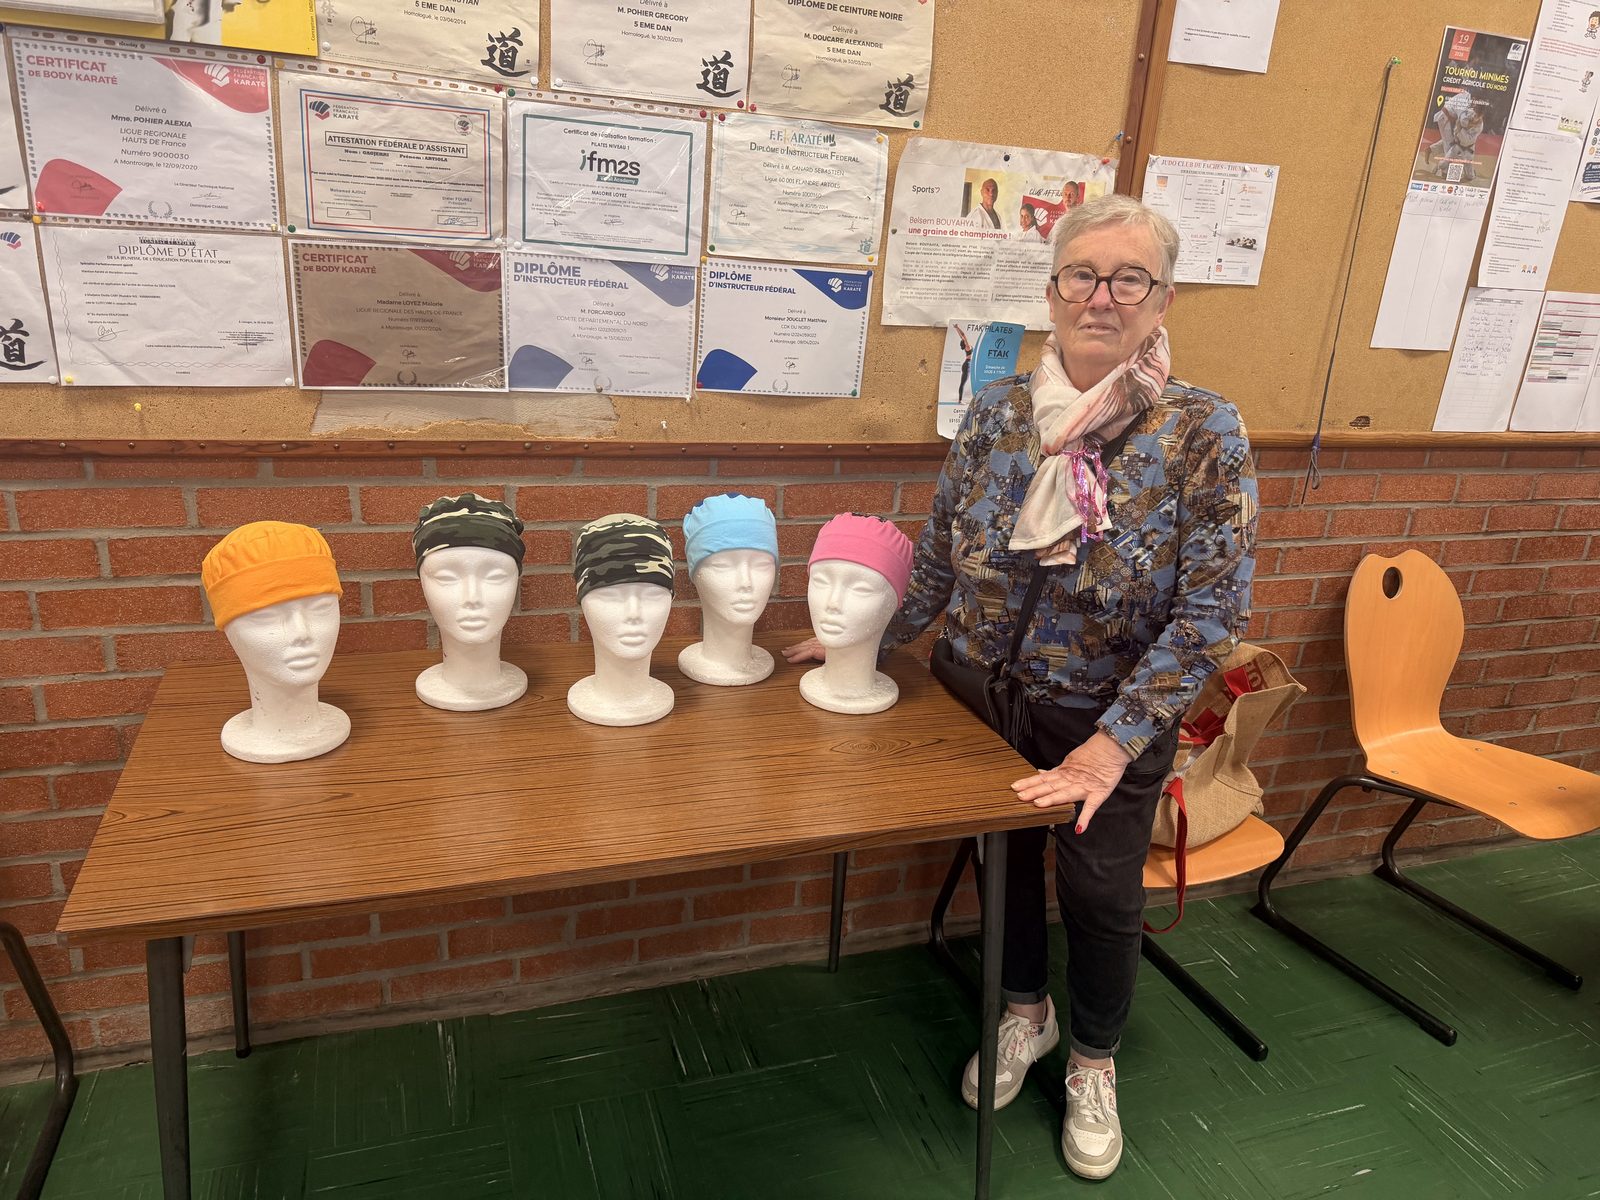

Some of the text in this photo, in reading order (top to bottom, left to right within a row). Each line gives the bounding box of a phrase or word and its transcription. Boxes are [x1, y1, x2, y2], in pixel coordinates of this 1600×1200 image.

[422, 2, 438, 10] EME
[440, 5, 456, 14] DAN
[840, 5, 878, 17] CEINTURE
[880, 11, 903, 21] NOIRE
[627, 8, 654, 18] POHIER
[654, 12, 688, 22] GREGORY
[640, 22, 655, 30] EME
[832, 25, 854, 34] Délivré
[813, 34, 844, 43] DOUCARE
[845, 38, 883, 48] ALEXANDRE
[1458, 34, 1469, 44] 19
[480, 27, 531, 78] 道
[26, 55, 107, 72] CERTIFICAT
[43, 70, 73, 80] BODY
[76, 73, 118, 85] KARATÉ
[696, 50, 744, 98] 道
[1445, 66, 1509, 83] TOURNOI MINIMES
[1461, 80, 1486, 88] AGRICOLE
[878, 73, 920, 117] 道
[135, 105, 160, 113] Délivré
[144, 130, 187, 139] REGIONALE
[564, 128, 589, 136] Certificat
[628, 135, 653, 143] formation
[328, 135, 465, 154] ATTESTATION FÉDÉRALE D'ASSISTANT
[153, 152, 189, 160] 9000030
[912, 185, 934, 194] Sports
[936, 218, 974, 228] BOUYAHYA
[923, 228, 947, 237] graine
[960, 230, 1007, 240] championne
[118, 244, 218, 258] DIPLÔME D'ÉTAT
[303, 253, 368, 264] CERTIFICAT
[342, 265, 376, 274] KARATÉ
[514, 262, 581, 277] DIPLÔME
[514, 275, 629, 289] D'INSTRUCTEUR FÉDÉRAL
[709, 271, 752, 282] DIPLÔME
[709, 282, 796, 294] D'INSTRUCTEUR FÉDÉRAL
[985, 326, 1014, 335] PILATES
[988, 350, 1009, 358] FTAK
